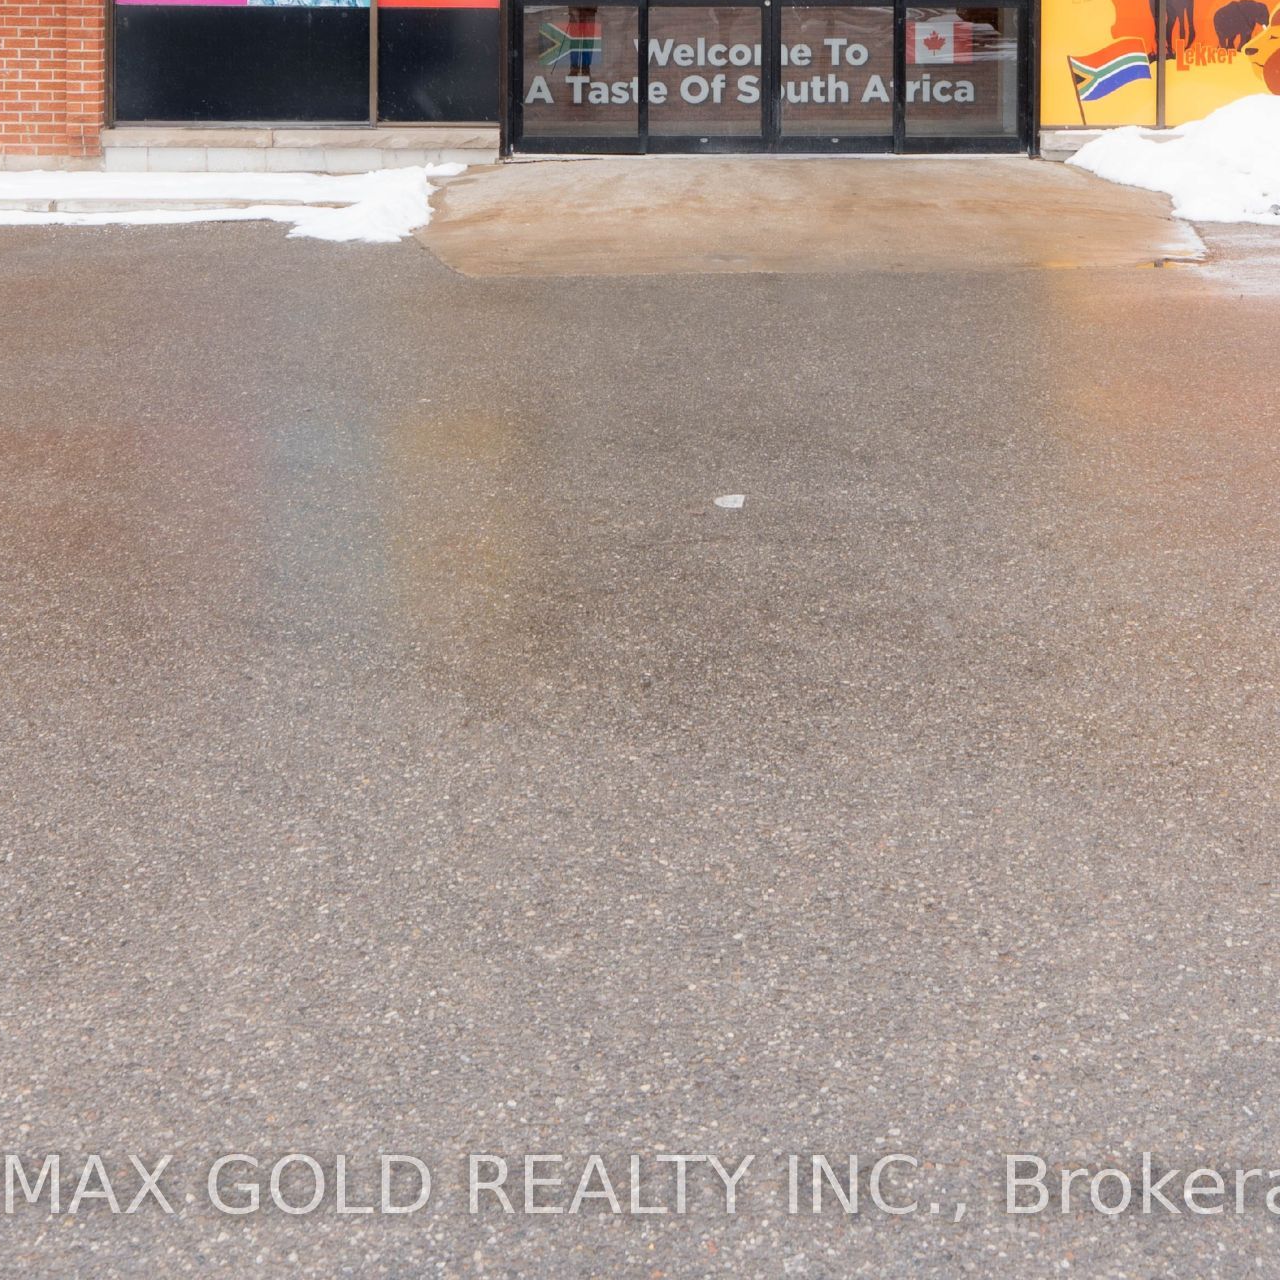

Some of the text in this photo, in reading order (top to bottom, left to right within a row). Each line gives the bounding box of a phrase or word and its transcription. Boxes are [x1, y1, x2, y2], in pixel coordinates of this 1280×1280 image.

[824, 38, 869, 66] To
[525, 75, 554, 104] A
[680, 74, 726, 104] Of
[737, 73, 850, 104] Suth
[860, 73, 975, 104] Arica
